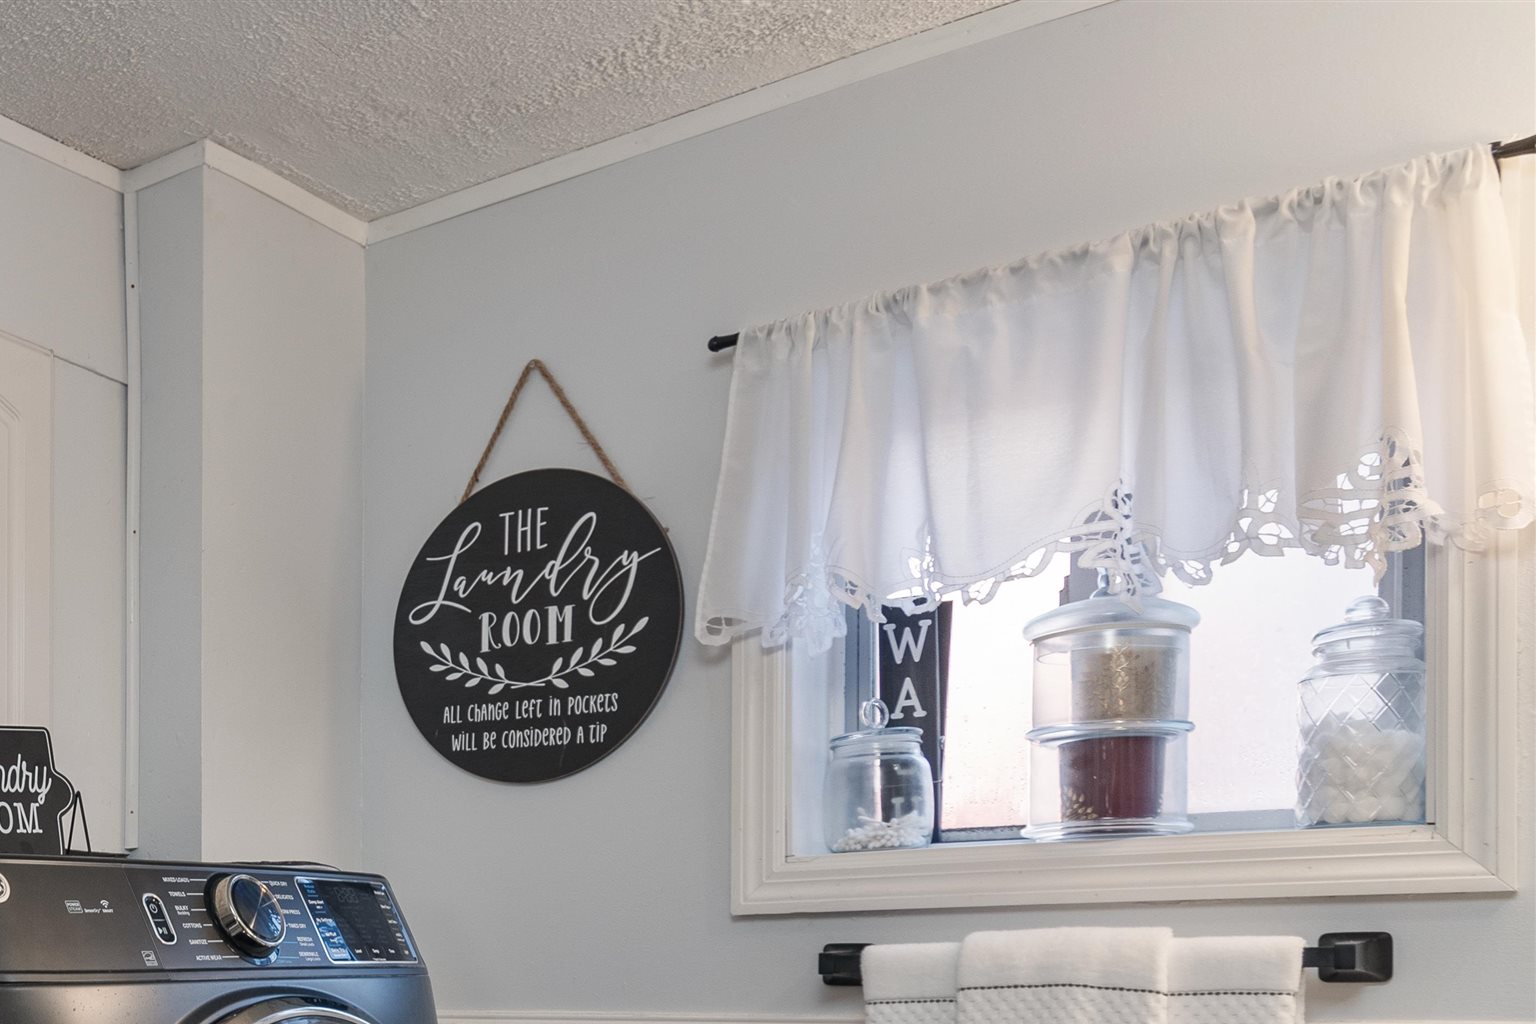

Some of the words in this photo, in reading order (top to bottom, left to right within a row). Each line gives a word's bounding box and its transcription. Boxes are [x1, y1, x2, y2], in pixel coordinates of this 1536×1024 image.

[499, 507, 549, 555] THE
[408, 511, 661, 625] Laundry
[479, 604, 576, 653] ROOM
[443, 705, 462, 724] ALL
[576, 725, 585, 744] A
